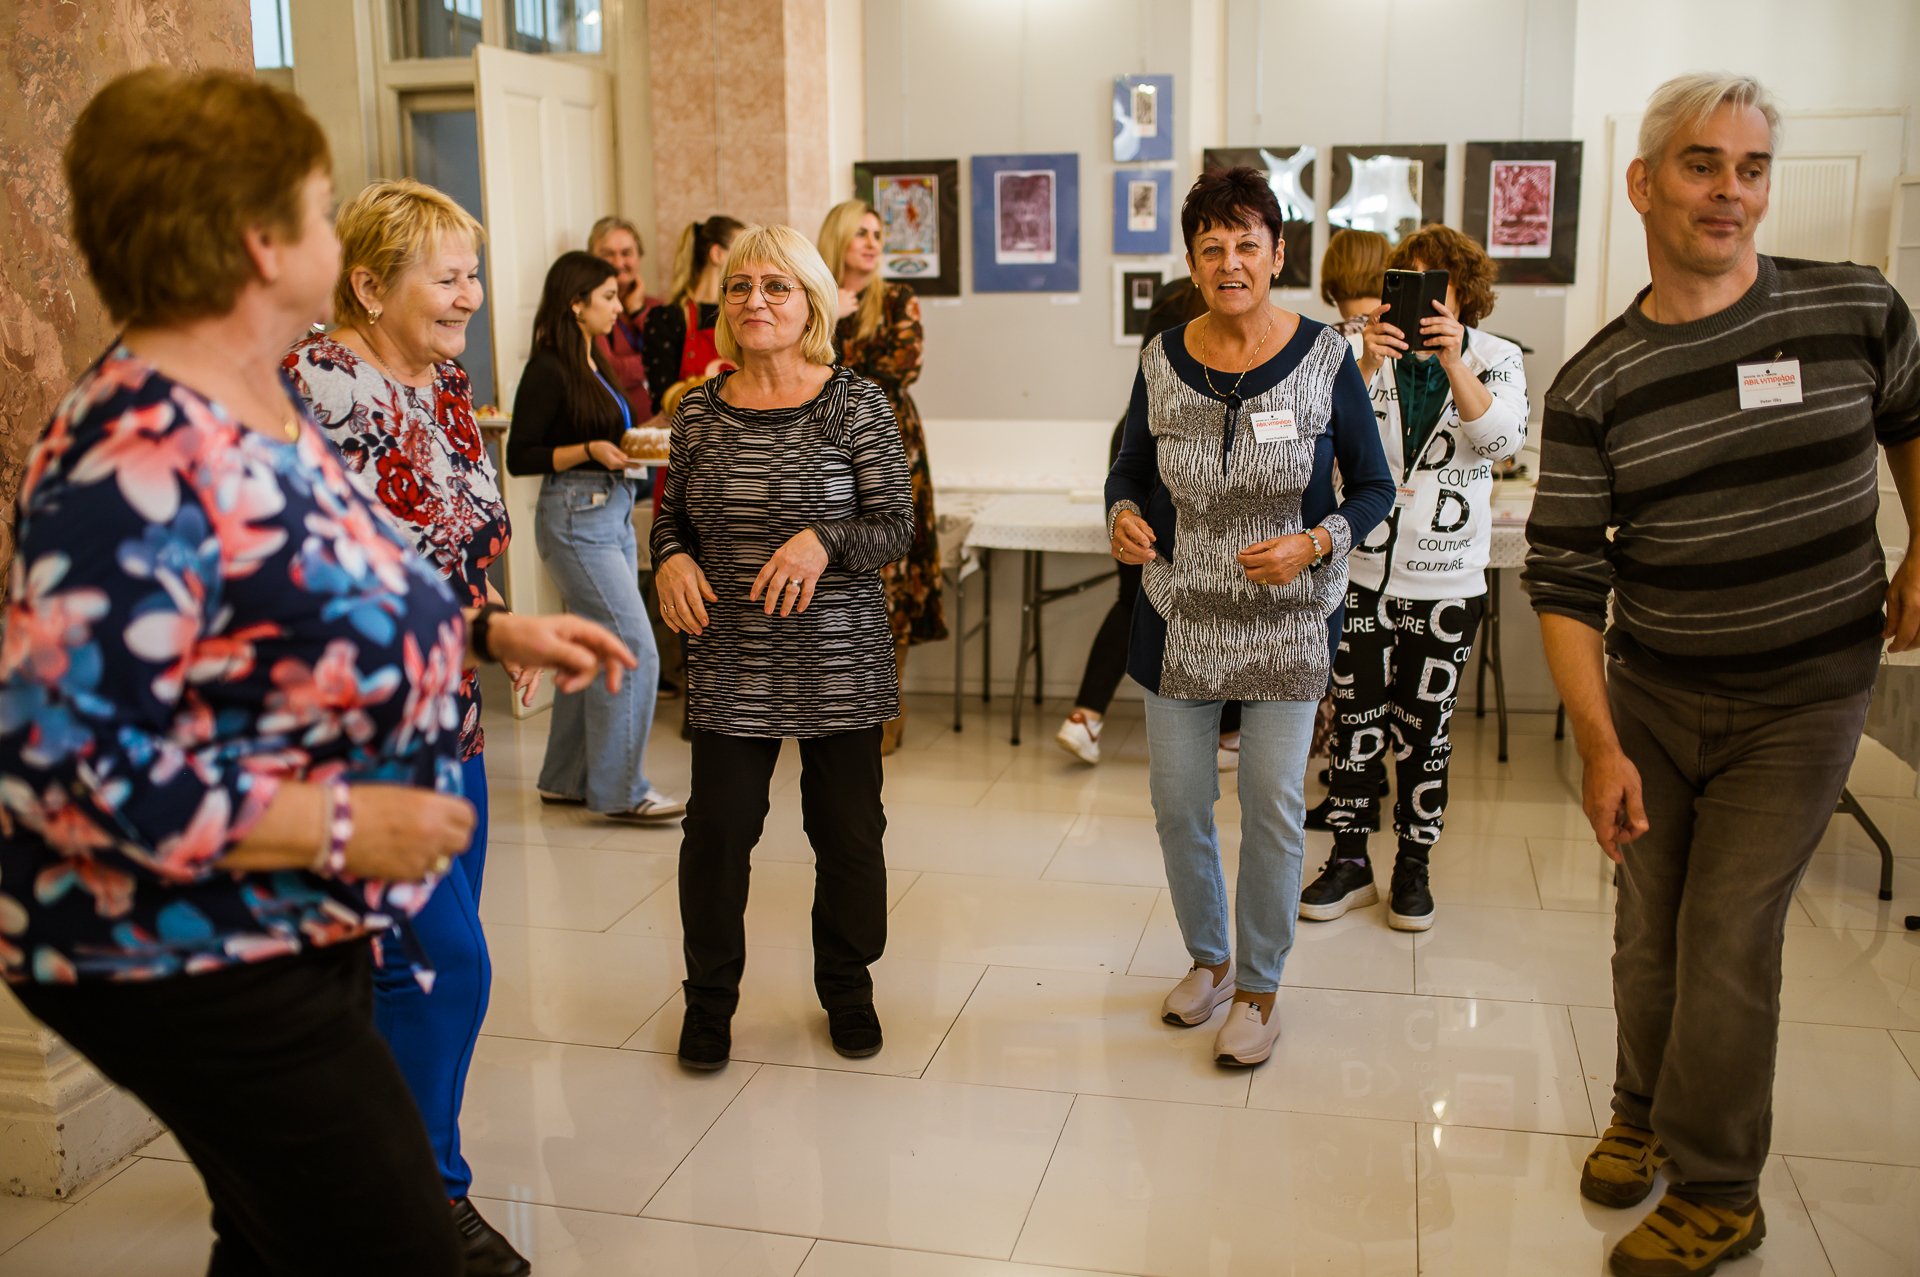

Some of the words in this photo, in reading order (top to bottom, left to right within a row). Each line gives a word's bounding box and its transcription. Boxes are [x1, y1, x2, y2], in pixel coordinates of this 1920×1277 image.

[1431, 488, 1470, 533] D
[1406, 558, 1463, 571] COUTURE
[1418, 537, 1472, 552] COUTURE
[1429, 598, 1466, 643] C
[1416, 656, 1458, 702] D
[1350, 727, 1385, 762] D
[1412, 779, 1443, 820] C
